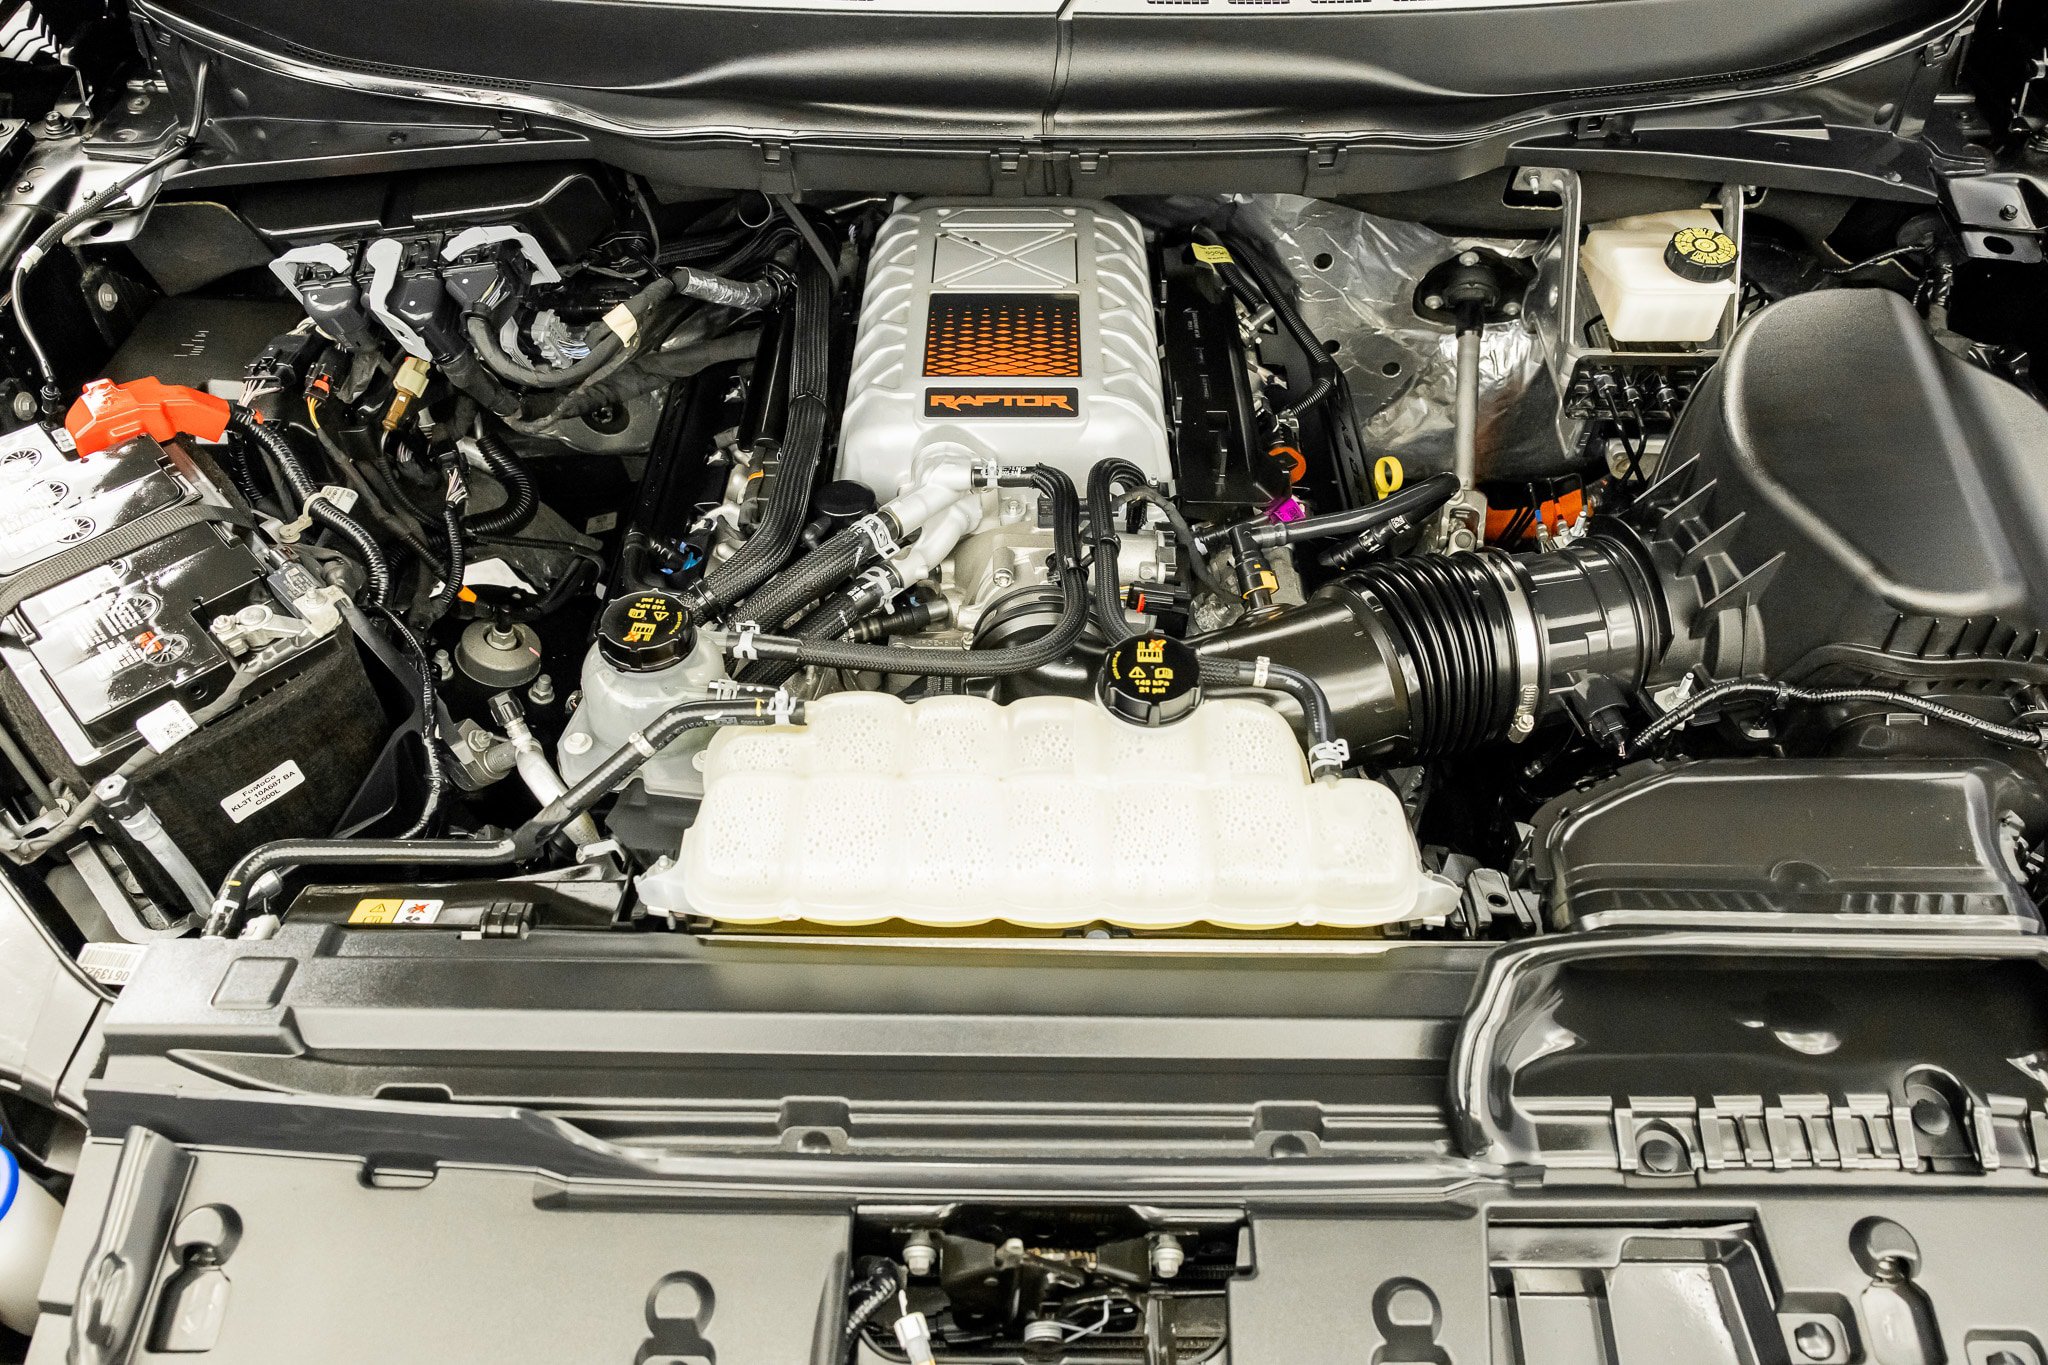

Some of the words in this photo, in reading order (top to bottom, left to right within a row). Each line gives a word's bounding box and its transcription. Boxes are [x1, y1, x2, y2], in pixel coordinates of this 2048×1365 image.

[930, 395, 1074, 412] RAPTOR
[1151, 686, 1166, 694] psi
[1152, 679, 1170, 687] kPa
[231, 797, 252, 812] KL3T
[254, 778, 281, 798] 10A687
[282, 771, 296, 781] BA
[242, 774, 276, 797] FoMoCo
